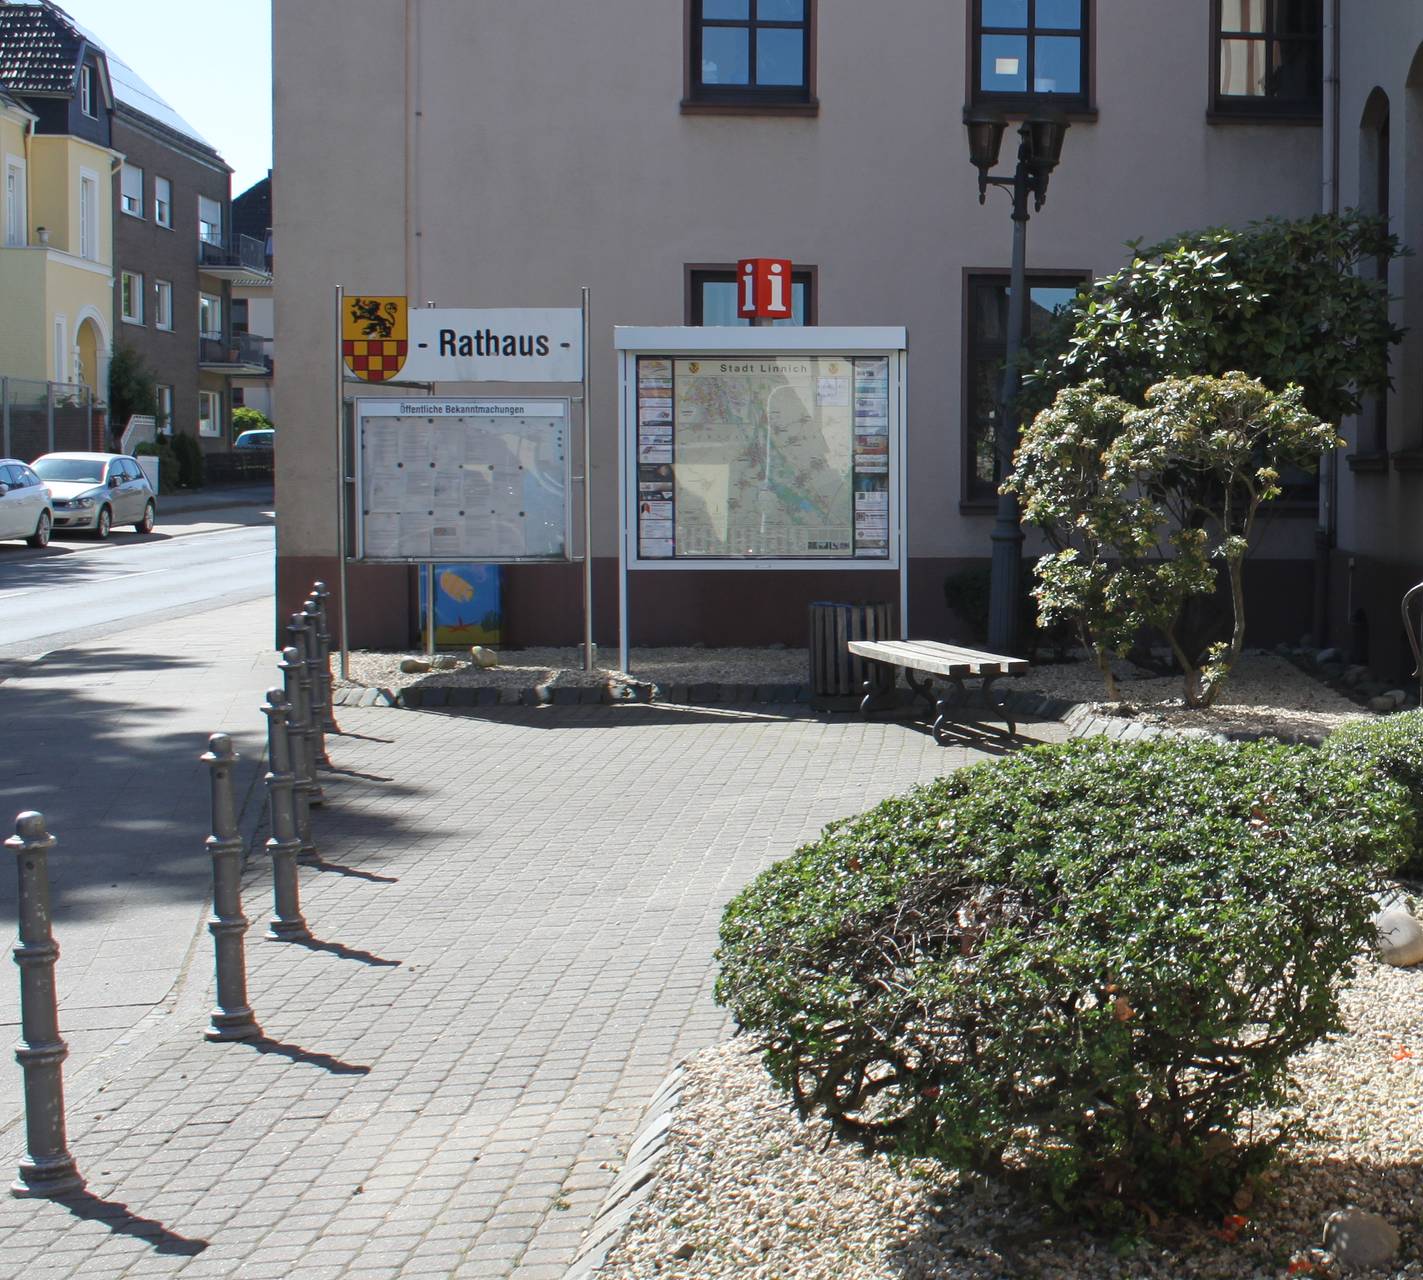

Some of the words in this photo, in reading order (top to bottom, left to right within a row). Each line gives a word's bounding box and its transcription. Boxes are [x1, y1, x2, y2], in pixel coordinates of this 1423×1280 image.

[743, 263, 755, 311] i
[767, 263, 786, 311] i
[439, 328, 550, 357] Rathaus
[720, 363, 754, 373] Stadt
[760, 363, 807, 373] Linnich
[400, 402, 443, 414] Öffentliche
[445, 404, 525, 415] Bekanntmachungen
